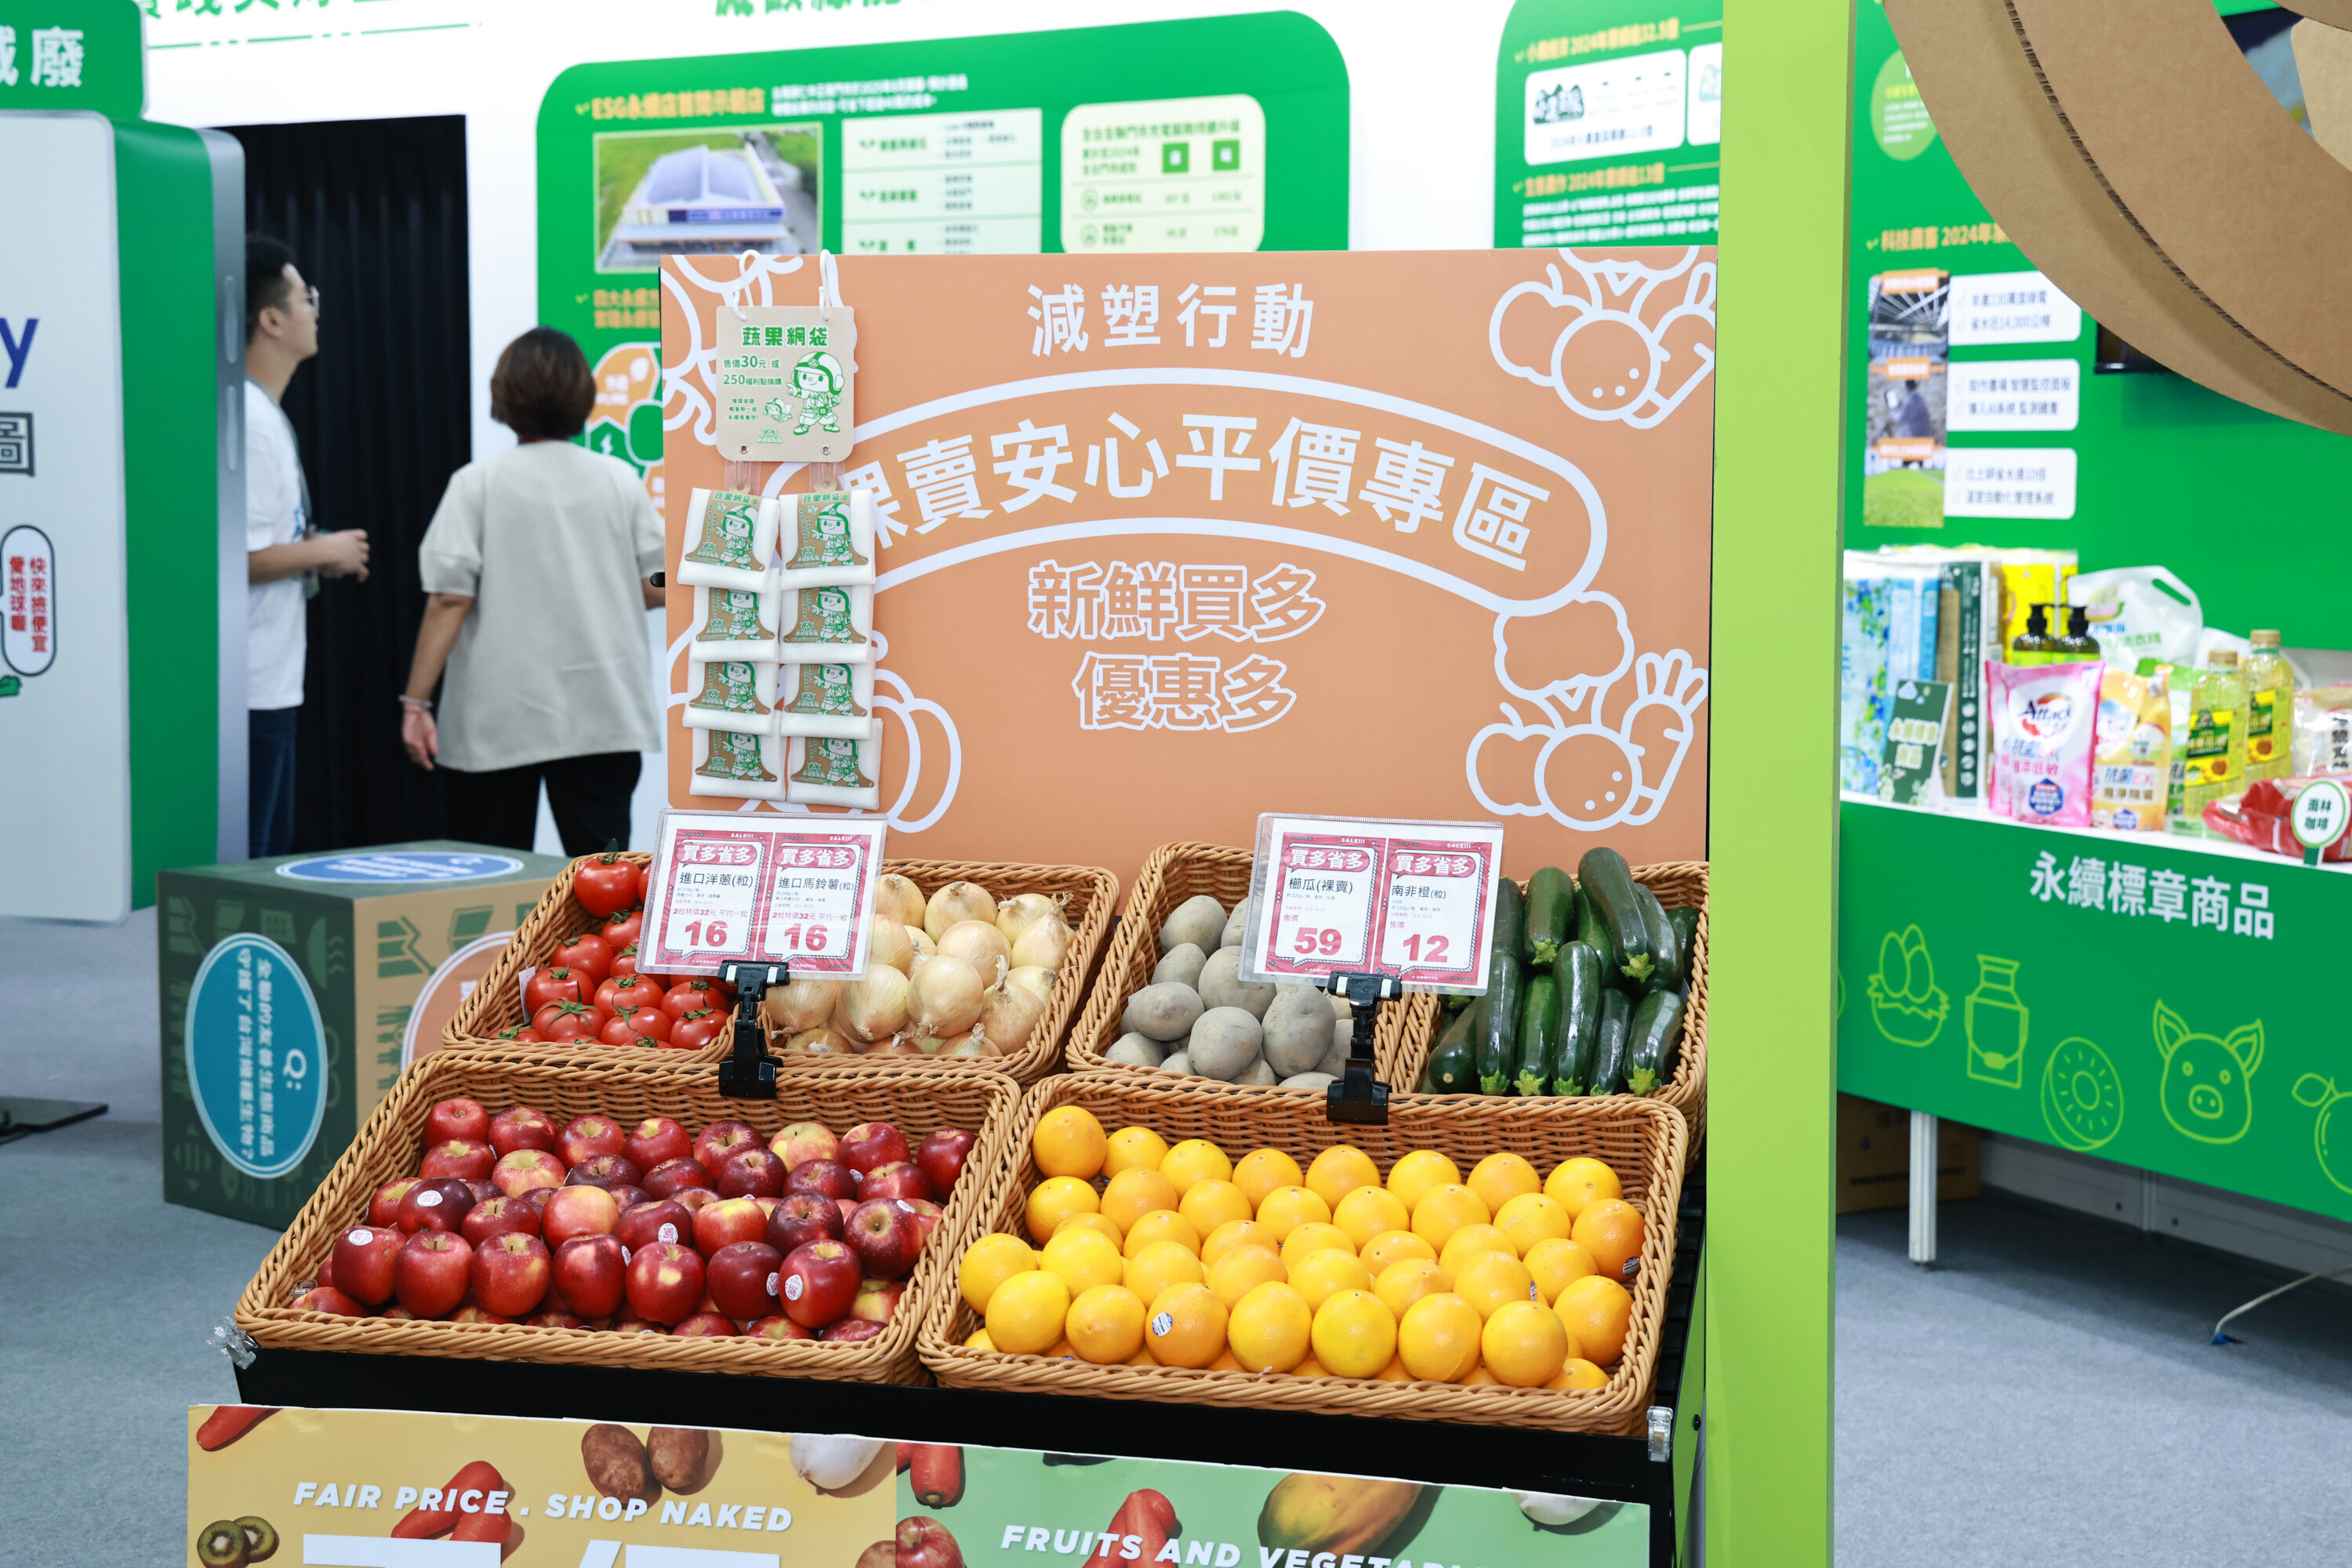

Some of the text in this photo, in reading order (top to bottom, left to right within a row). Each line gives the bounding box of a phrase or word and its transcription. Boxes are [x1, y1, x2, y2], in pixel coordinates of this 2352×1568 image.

[1027, 282, 1315, 358] 減塑行動
[742, 326, 828, 347] 蔬果網袋
[723, 354, 780, 369] 售價30元 或
[723, 374, 782, 386] 250福利點換購
[1027, 560, 1327, 643] 新鮮買多
[1072, 651, 1298, 733] 優惠多
[2304, 816, 2328, 831] 咖啡
[682, 844, 751, 863] 買多省多
[780, 848, 850, 866] 買多省多
[1290, 848, 1363, 869] 買多省多
[1395, 855, 1470, 875] 買多省多
[679, 872, 753, 888] 進口洋蔥(粒)
[778, 877, 855, 891] 進口馬鈴薯(粒)
[1289, 877, 1353, 895] 櫛瓜(裸賣)
[1392, 884, 1446, 900] 南非橙(粒)
[2030, 850, 2275, 940] 永續標章商品
[673, 908, 748, 917] 2粒特價32元 平均一粒
[771, 912, 848, 921] 2粒特價32元 平均一粒
[684, 919, 728, 947] 16
[784, 923, 828, 952] 16
[1294, 927, 1342, 956] 59
[1403, 934, 1450, 963] 12
[293, 1481, 383, 1510] FAIR
[394, 1486, 510, 1515] PRICE
[544, 1494, 648, 1523] SHOP
[659, 1500, 794, 1533] NAKED
[1000, 1524, 1145, 1560] FRUITS
[1155, 1537, 1243, 1568] AND
